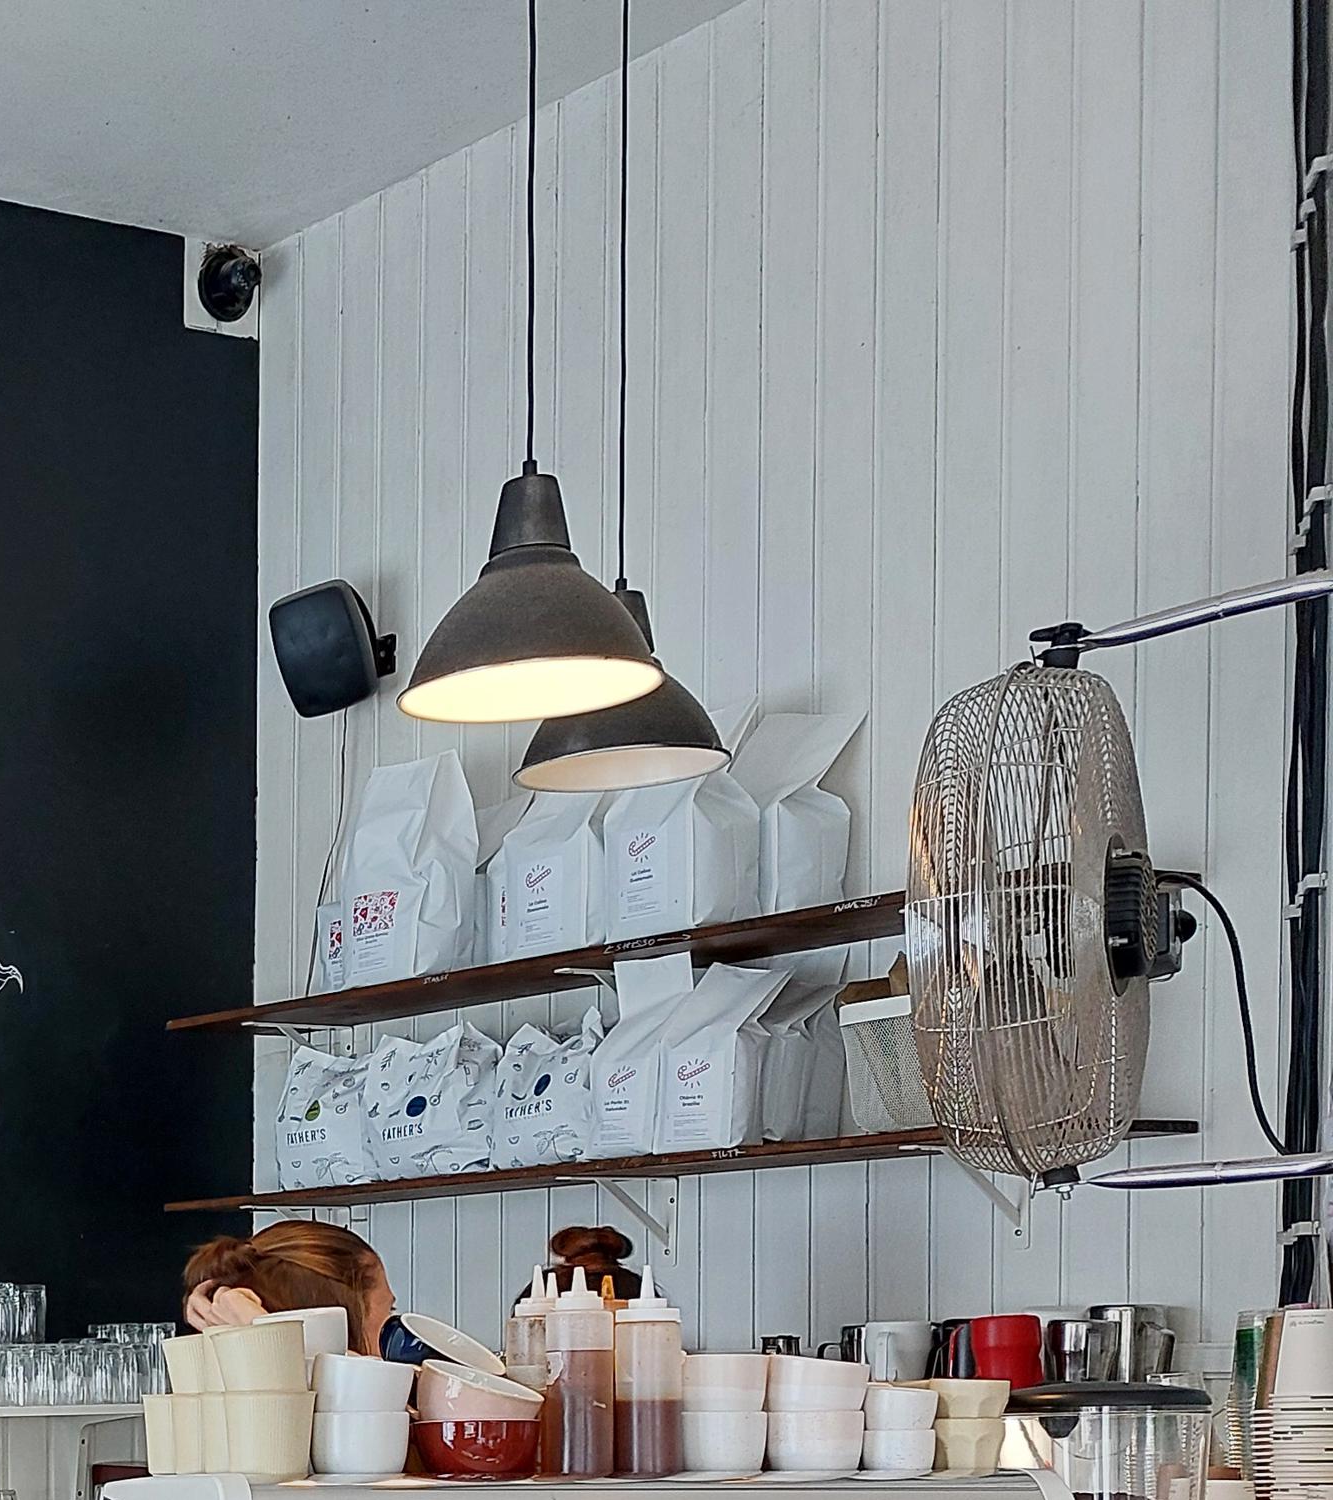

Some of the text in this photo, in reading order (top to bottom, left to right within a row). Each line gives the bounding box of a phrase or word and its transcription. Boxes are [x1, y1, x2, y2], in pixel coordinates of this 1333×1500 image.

[505, 1099, 553, 1120] FATHER'S
[287, 1128, 327, 1147] FATHER'S
[382, 1123, 424, 1141] FATHER'S
